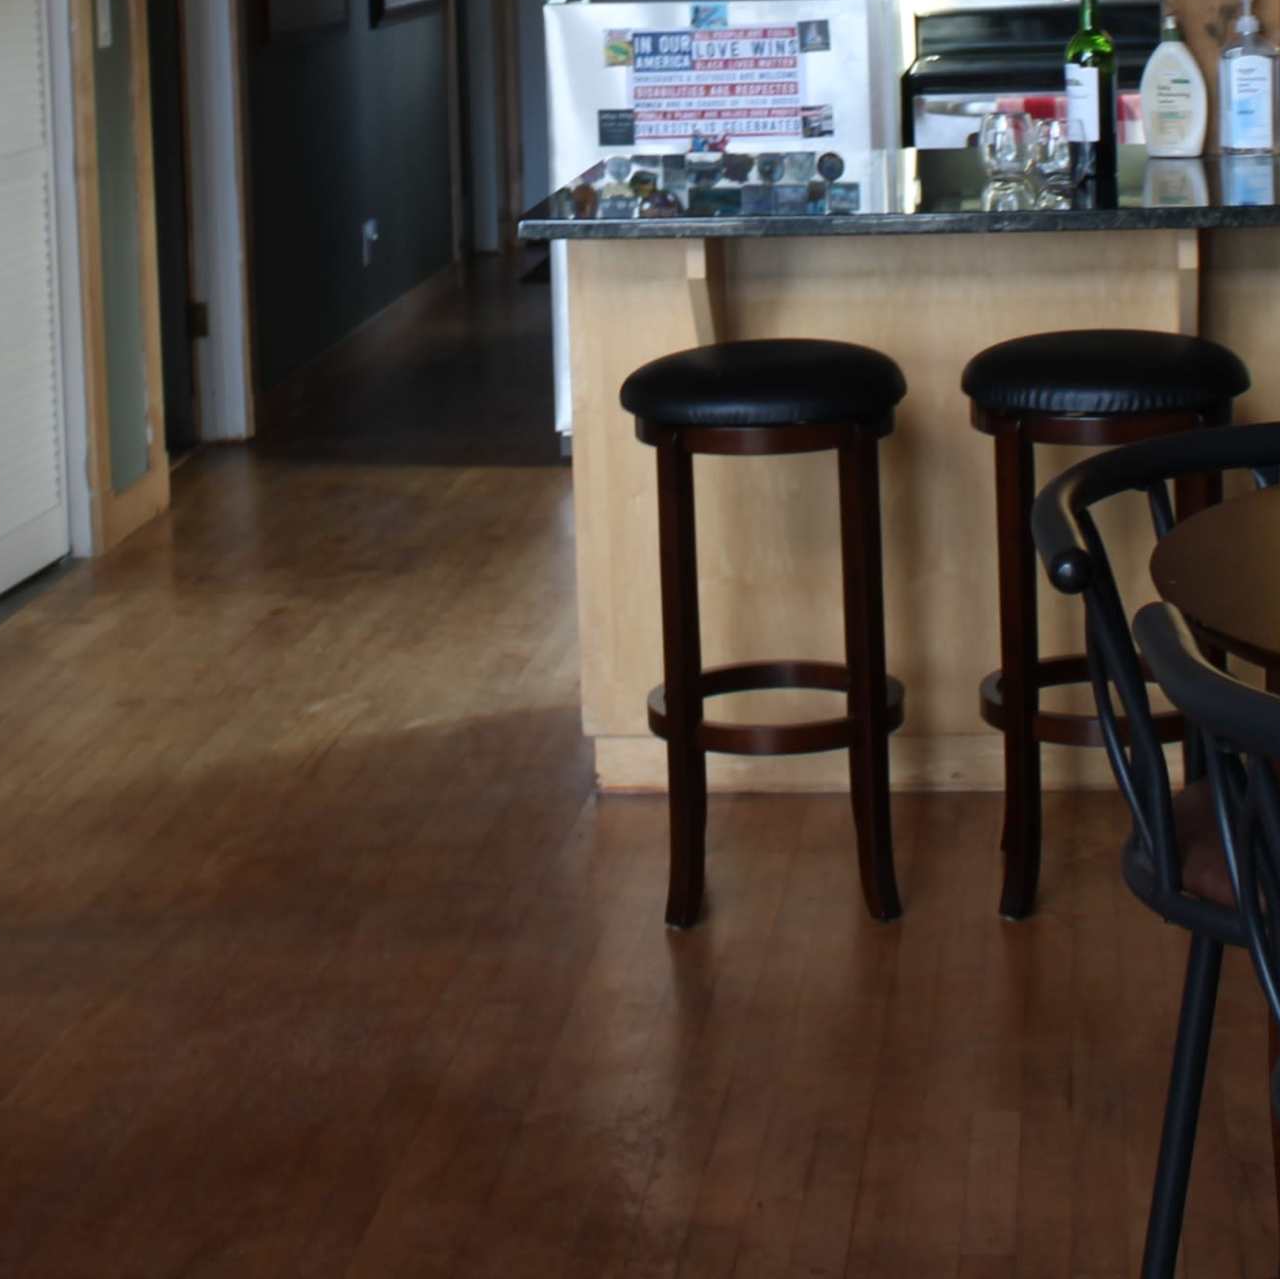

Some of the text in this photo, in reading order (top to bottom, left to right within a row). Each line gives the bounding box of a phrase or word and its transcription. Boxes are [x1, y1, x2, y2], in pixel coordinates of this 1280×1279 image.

[634, 34, 691, 54] IN OUR
[696, 39, 798, 58] LOVE WINS
[636, 55, 690, 69] AMERICA
[695, 57, 795, 70] BLACK LIVES MATTER
[636, 82, 796, 98] DISABILITIES ARE RESPECTED
[634, 122, 697, 135] DIVERSITY
[723, 119, 801, 133] CELEBRATED
